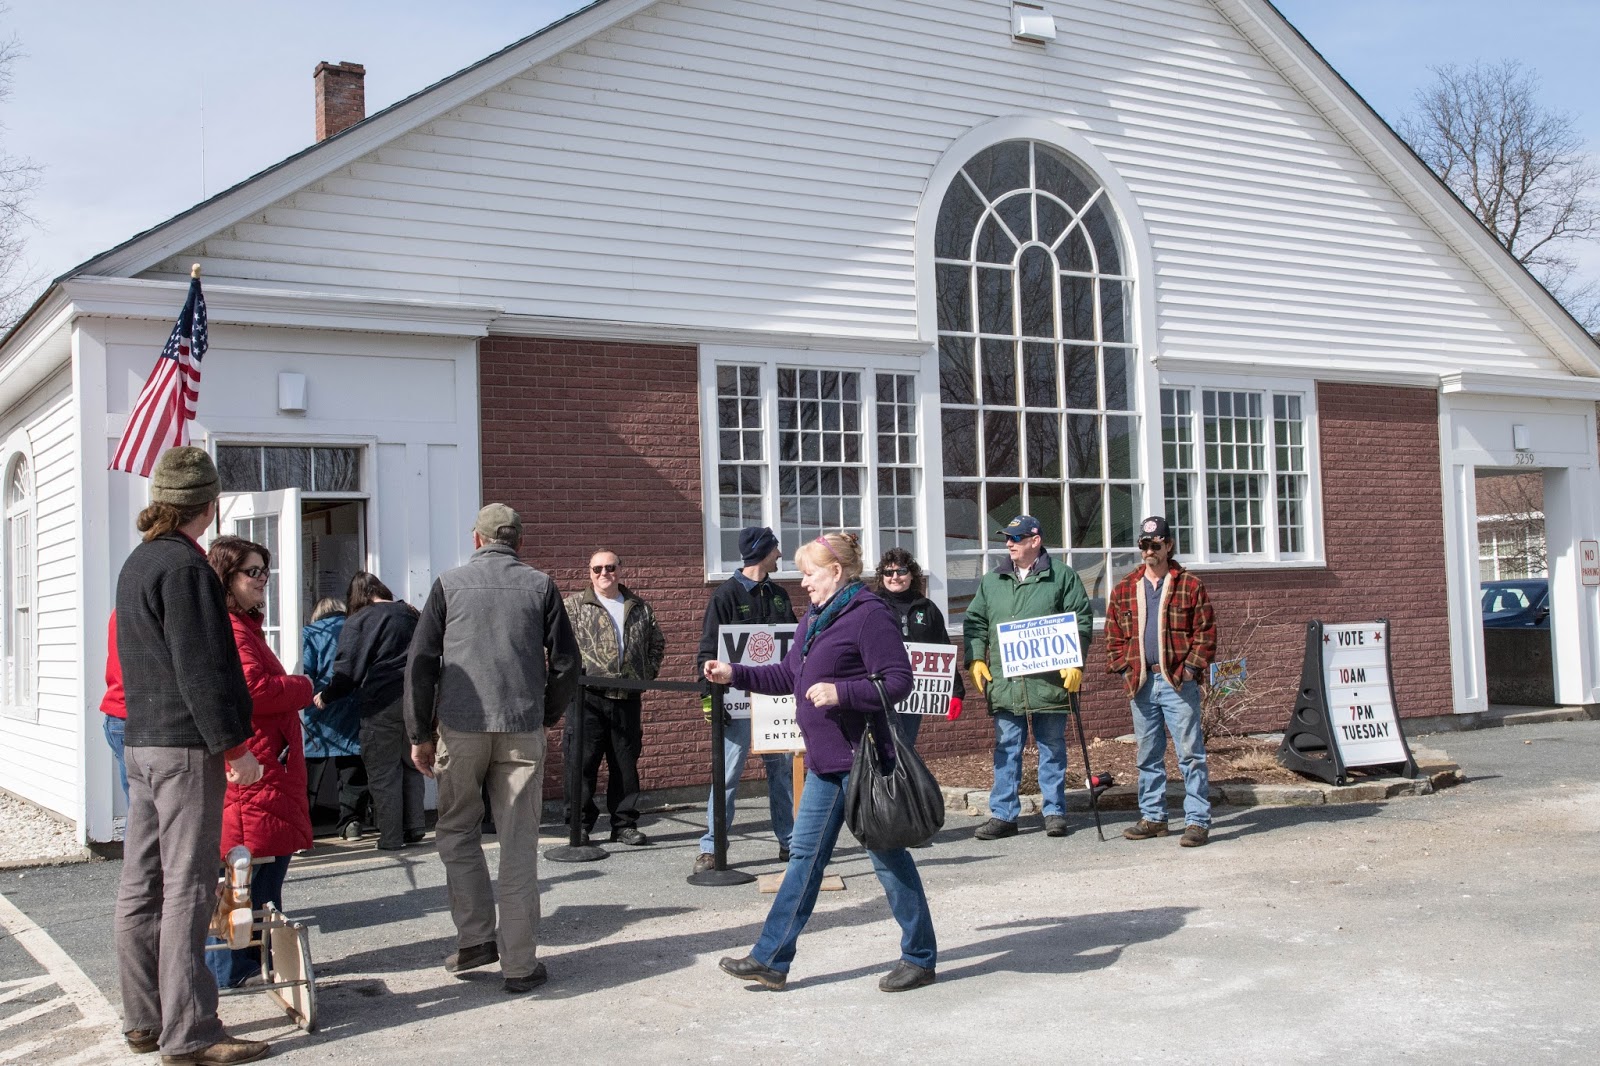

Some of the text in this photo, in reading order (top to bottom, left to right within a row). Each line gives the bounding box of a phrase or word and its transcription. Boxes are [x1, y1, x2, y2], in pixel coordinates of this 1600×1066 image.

[1515, 453, 1534, 465] 5259
[1585, 550, 1594, 561] NO
[1582, 568, 1599, 576] PARKING
[1026, 621, 1038, 630] for
[1039, 617, 1066, 626] Change
[1018, 625, 1058, 639] CHARLES
[1338, 631, 1364, 646] VOTE
[1003, 632, 1078, 663] HORTON
[1007, 655, 1079, 673] for Select Board
[1340, 668, 1366, 684] 10AM
[734, 702, 752, 711] SUP
[898, 692, 950, 715] BOARD
[1350, 705, 1374, 721] 7PM
[1342, 722, 1389, 740] TUESDAY
